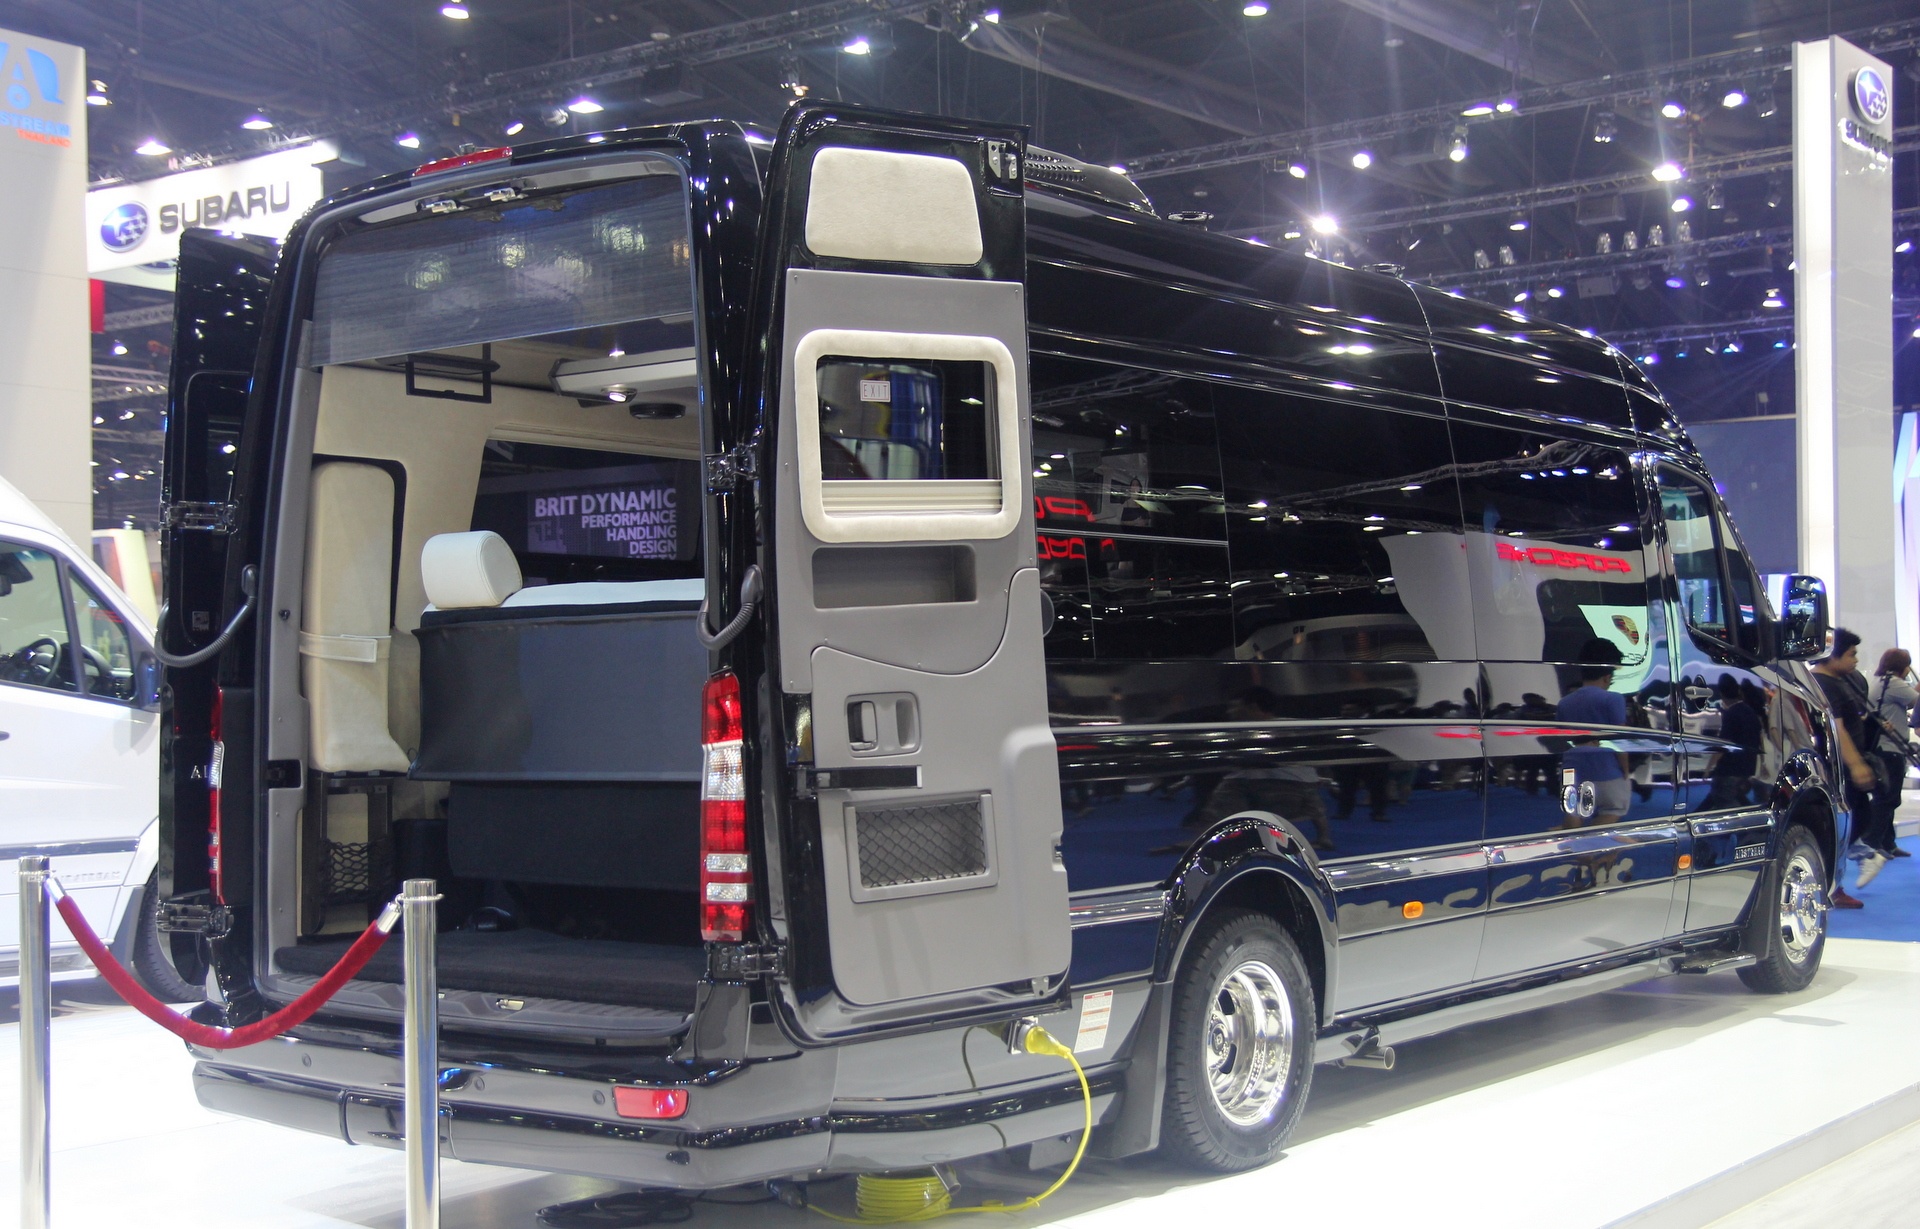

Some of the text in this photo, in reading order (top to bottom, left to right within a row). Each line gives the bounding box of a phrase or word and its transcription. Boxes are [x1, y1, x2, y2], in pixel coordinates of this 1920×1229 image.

[159, 181, 291, 235] SUBARU
[863, 384, 888, 399] EXIT
[535, 488, 677, 517] BRIT DYNAMIC
[581, 509, 677, 529] PERFORMANCE
[606, 524, 677, 542] HANDLING
[629, 539, 677, 555] DESIGN
